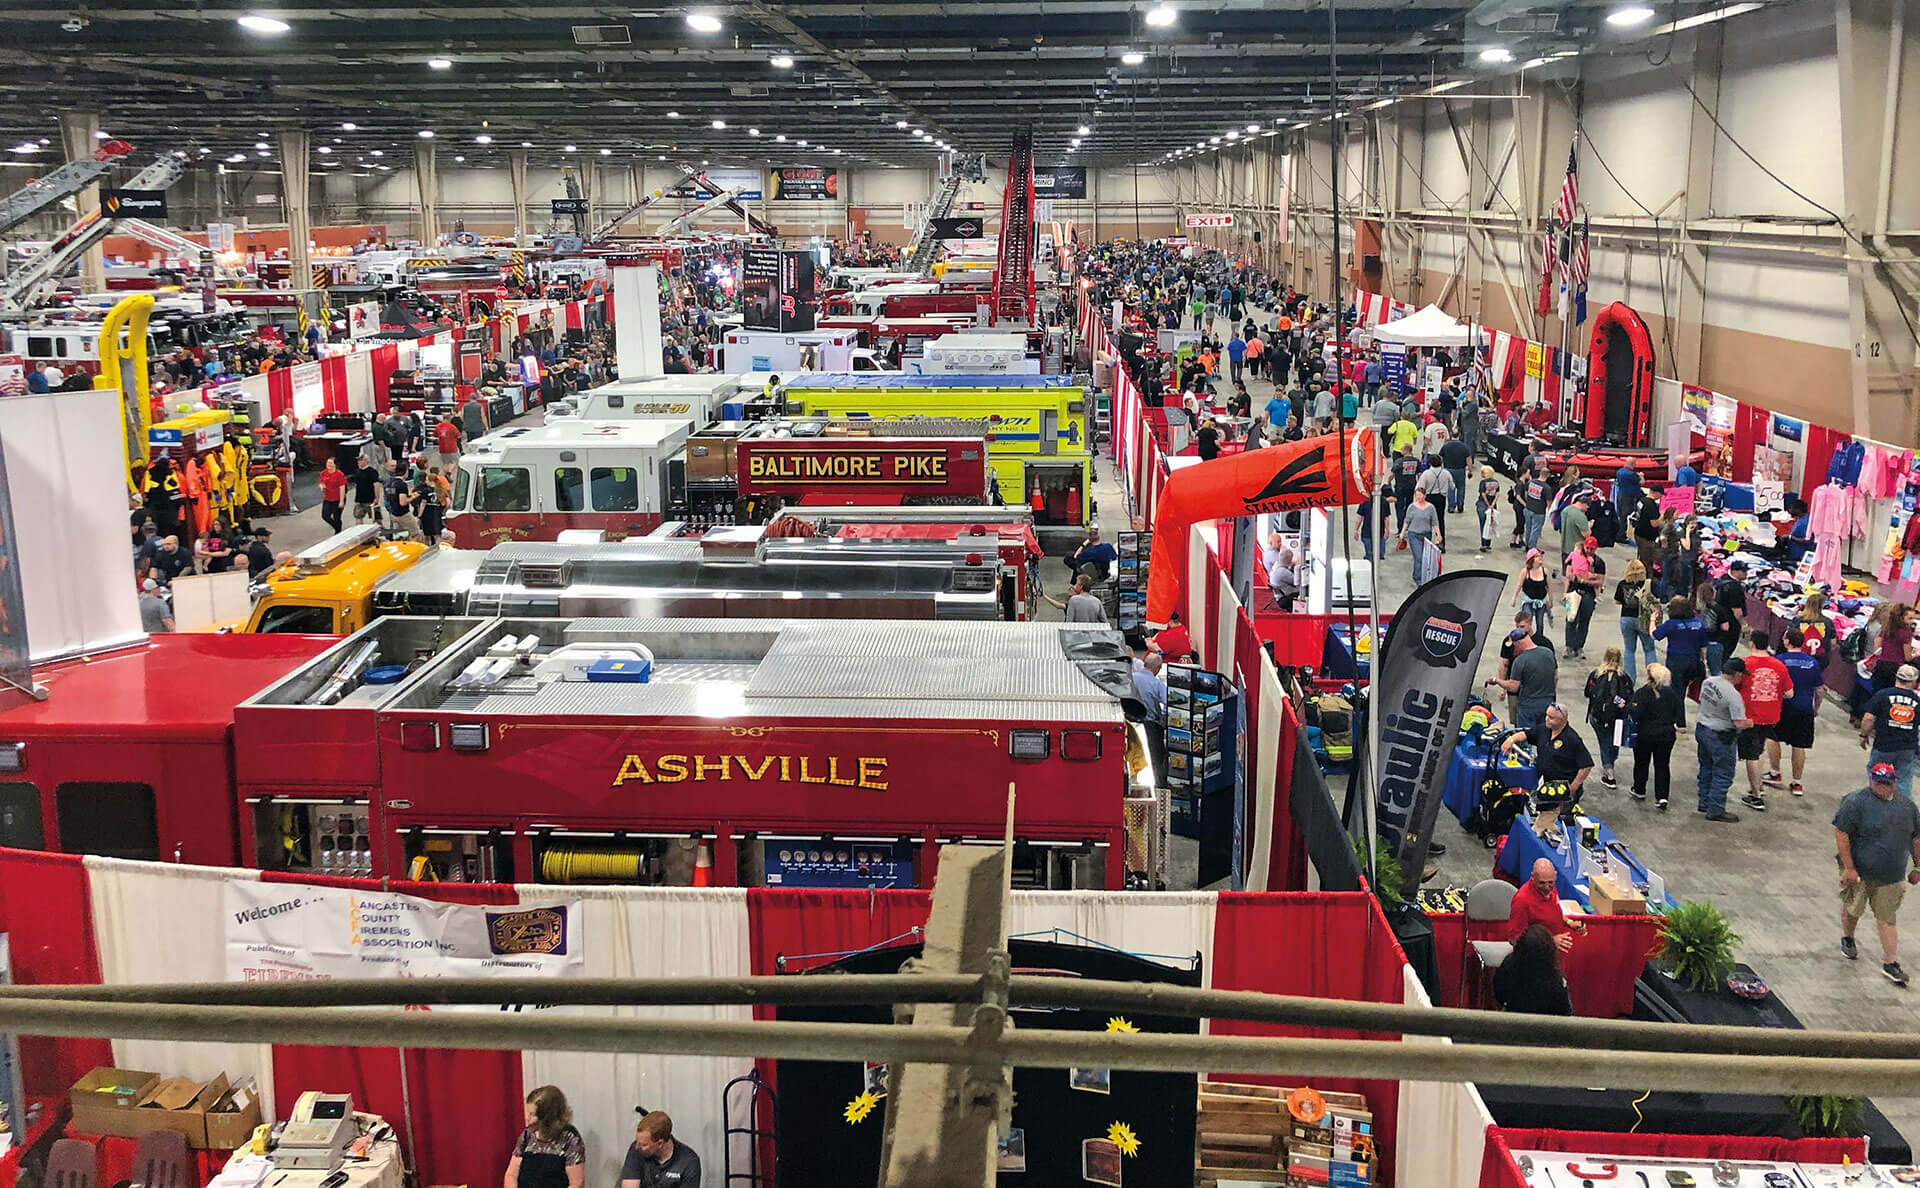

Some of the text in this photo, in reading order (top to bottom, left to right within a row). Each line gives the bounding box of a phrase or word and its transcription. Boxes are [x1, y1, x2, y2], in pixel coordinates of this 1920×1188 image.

[1187, 217, 1223, 226] EXIT
[1870, 341, 1880, 357] 12
[749, 457, 948, 478] BALTIMORE PIKE
[1244, 493, 1340, 515] STATMedEvac
[1425, 630, 1457, 645] RESCUE
[611, 754, 889, 790] ASHVILLE
